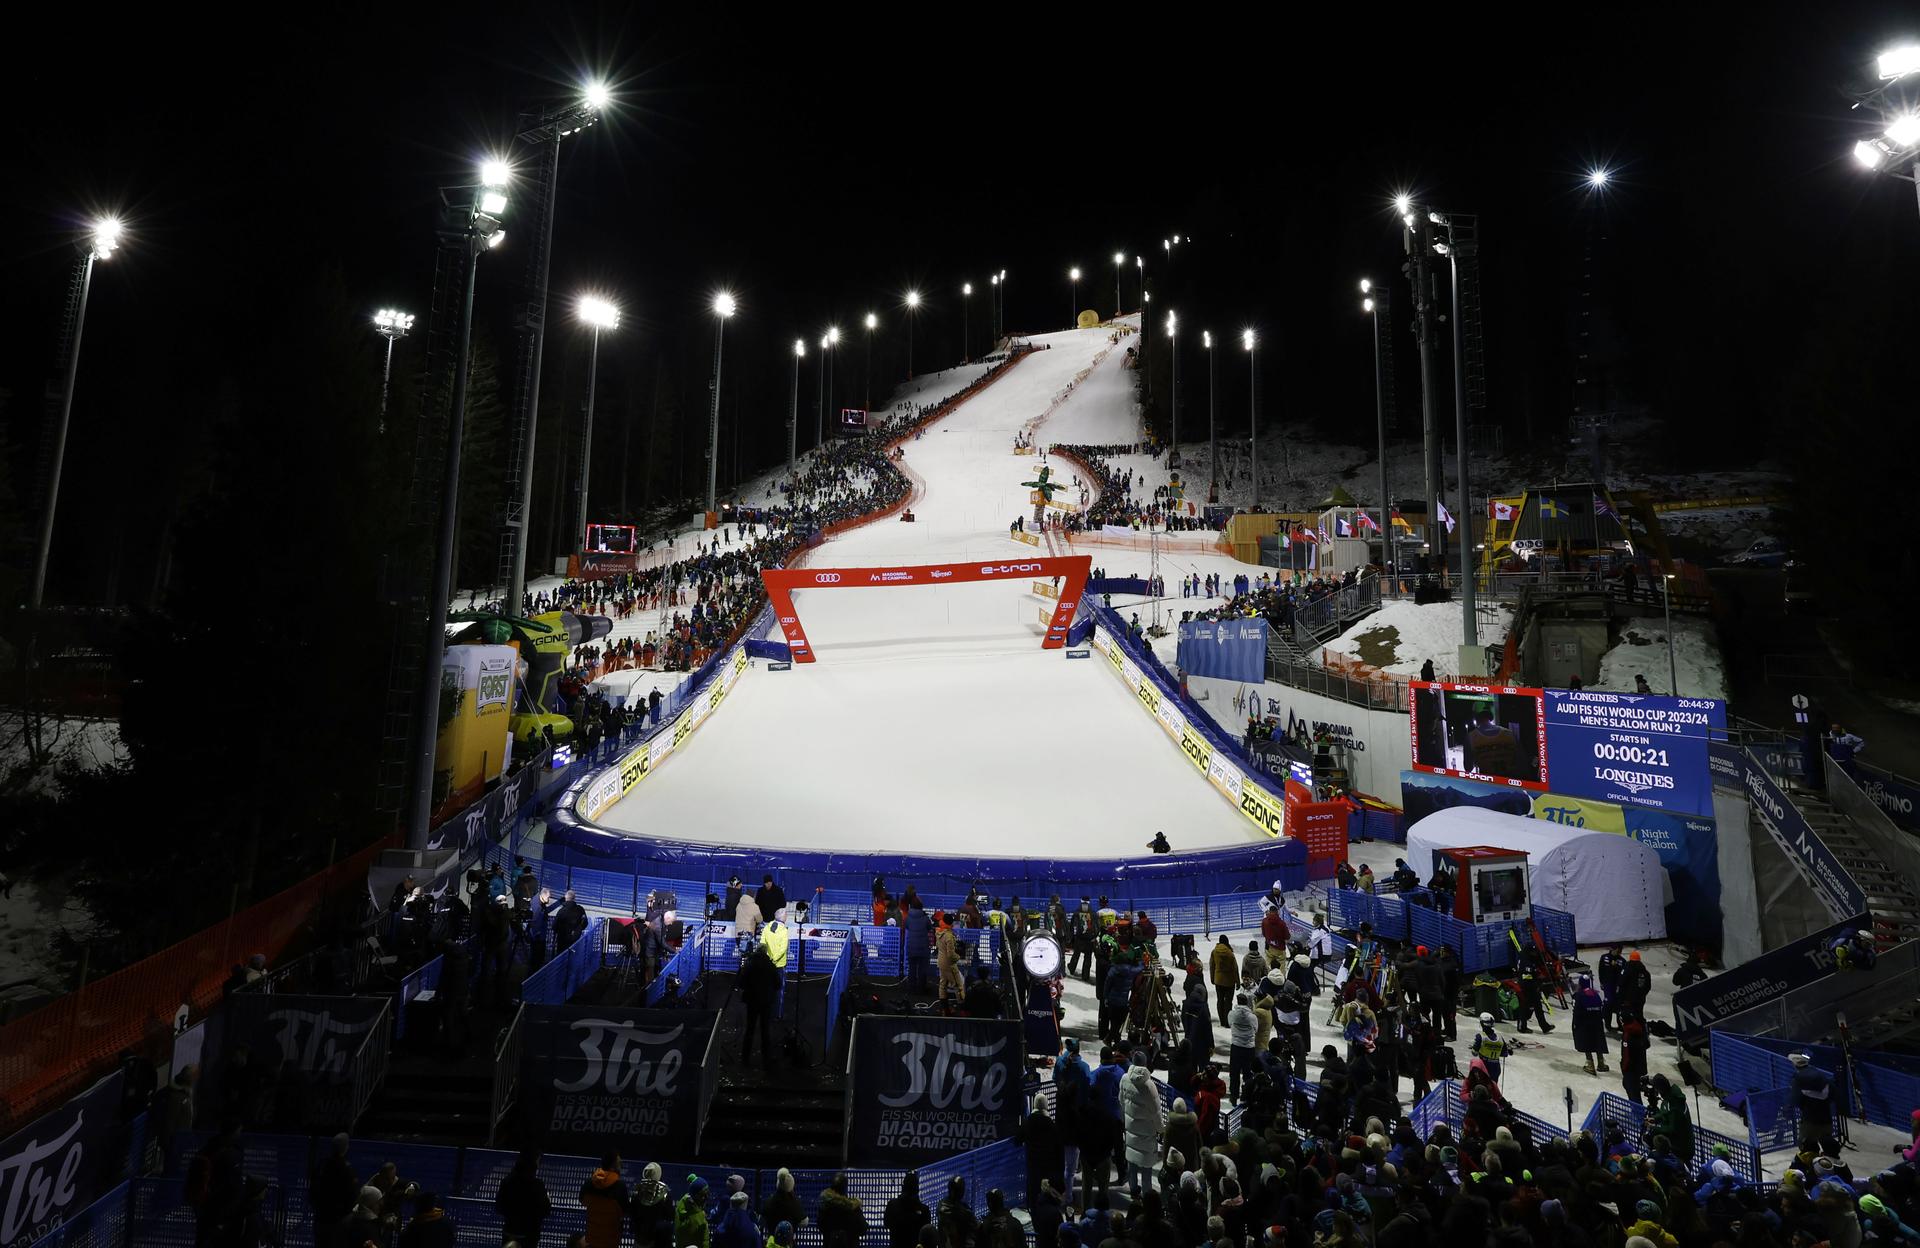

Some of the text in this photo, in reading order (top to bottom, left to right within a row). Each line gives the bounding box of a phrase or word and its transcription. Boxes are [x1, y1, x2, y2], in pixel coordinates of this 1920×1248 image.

[981, 562, 1042, 574] e-tron
[480, 675, 509, 700] FORST
[1455, 684, 1489, 692] e-tron
[1138, 684, 1159, 713] ZGONC
[1569, 692, 1618, 704] LONGINES
[1678, 699, 1715, 710] 20:44:39
[1557, 703, 1708, 725] AUDI FIS SKI WORLD CUP 2023/24
[1580, 716, 1681, 733] MEN'S SLALOM RUN 2
[1610, 733, 1649, 745] STARTS IN
[1182, 733, 1209, 771] ZGONC
[1593, 742, 1669, 767] 00:00:21
[621, 757, 649, 791] ZGONC
[1459, 771, 1494, 782] e-tron
[1594, 766, 1674, 789] LONGINES
[1607, 793, 1663, 807] OFFICIAL TIMEKEEPER
[1745, 768, 1784, 820] TRENTINO
[1864, 780, 1913, 813] TRENTINO
[1241, 791, 1280, 835] ZGONC
[1641, 828, 1671, 841] Night
[1686, 821, 1712, 832] TRENTINO
[1642, 838, 1678, 850] Slalom
[1817, 857, 1849, 899] MADONNA
[821, 929, 848, 938] SPORT
[1711, 977, 1769, 1006] MADONNA
[1718, 981, 1788, 1016] DI CAMPIGLIO
[553, 1018, 684, 1096] 3Tre
[877, 1032, 1007, 1111] 3Tre
[555, 1095, 673, 1109] FIS SKI WORLD CUP
[553, 1105, 670, 1124] MADONNA
[881, 1110, 1002, 1123] FIS SKI WORLD CUP
[550, 1120, 669, 1136] DI CAMPIGLIO
[880, 1120, 998, 1138] MADONNA
[877, 1135, 894, 1147] DI
[0, 1109, 83, 1245] Tre
